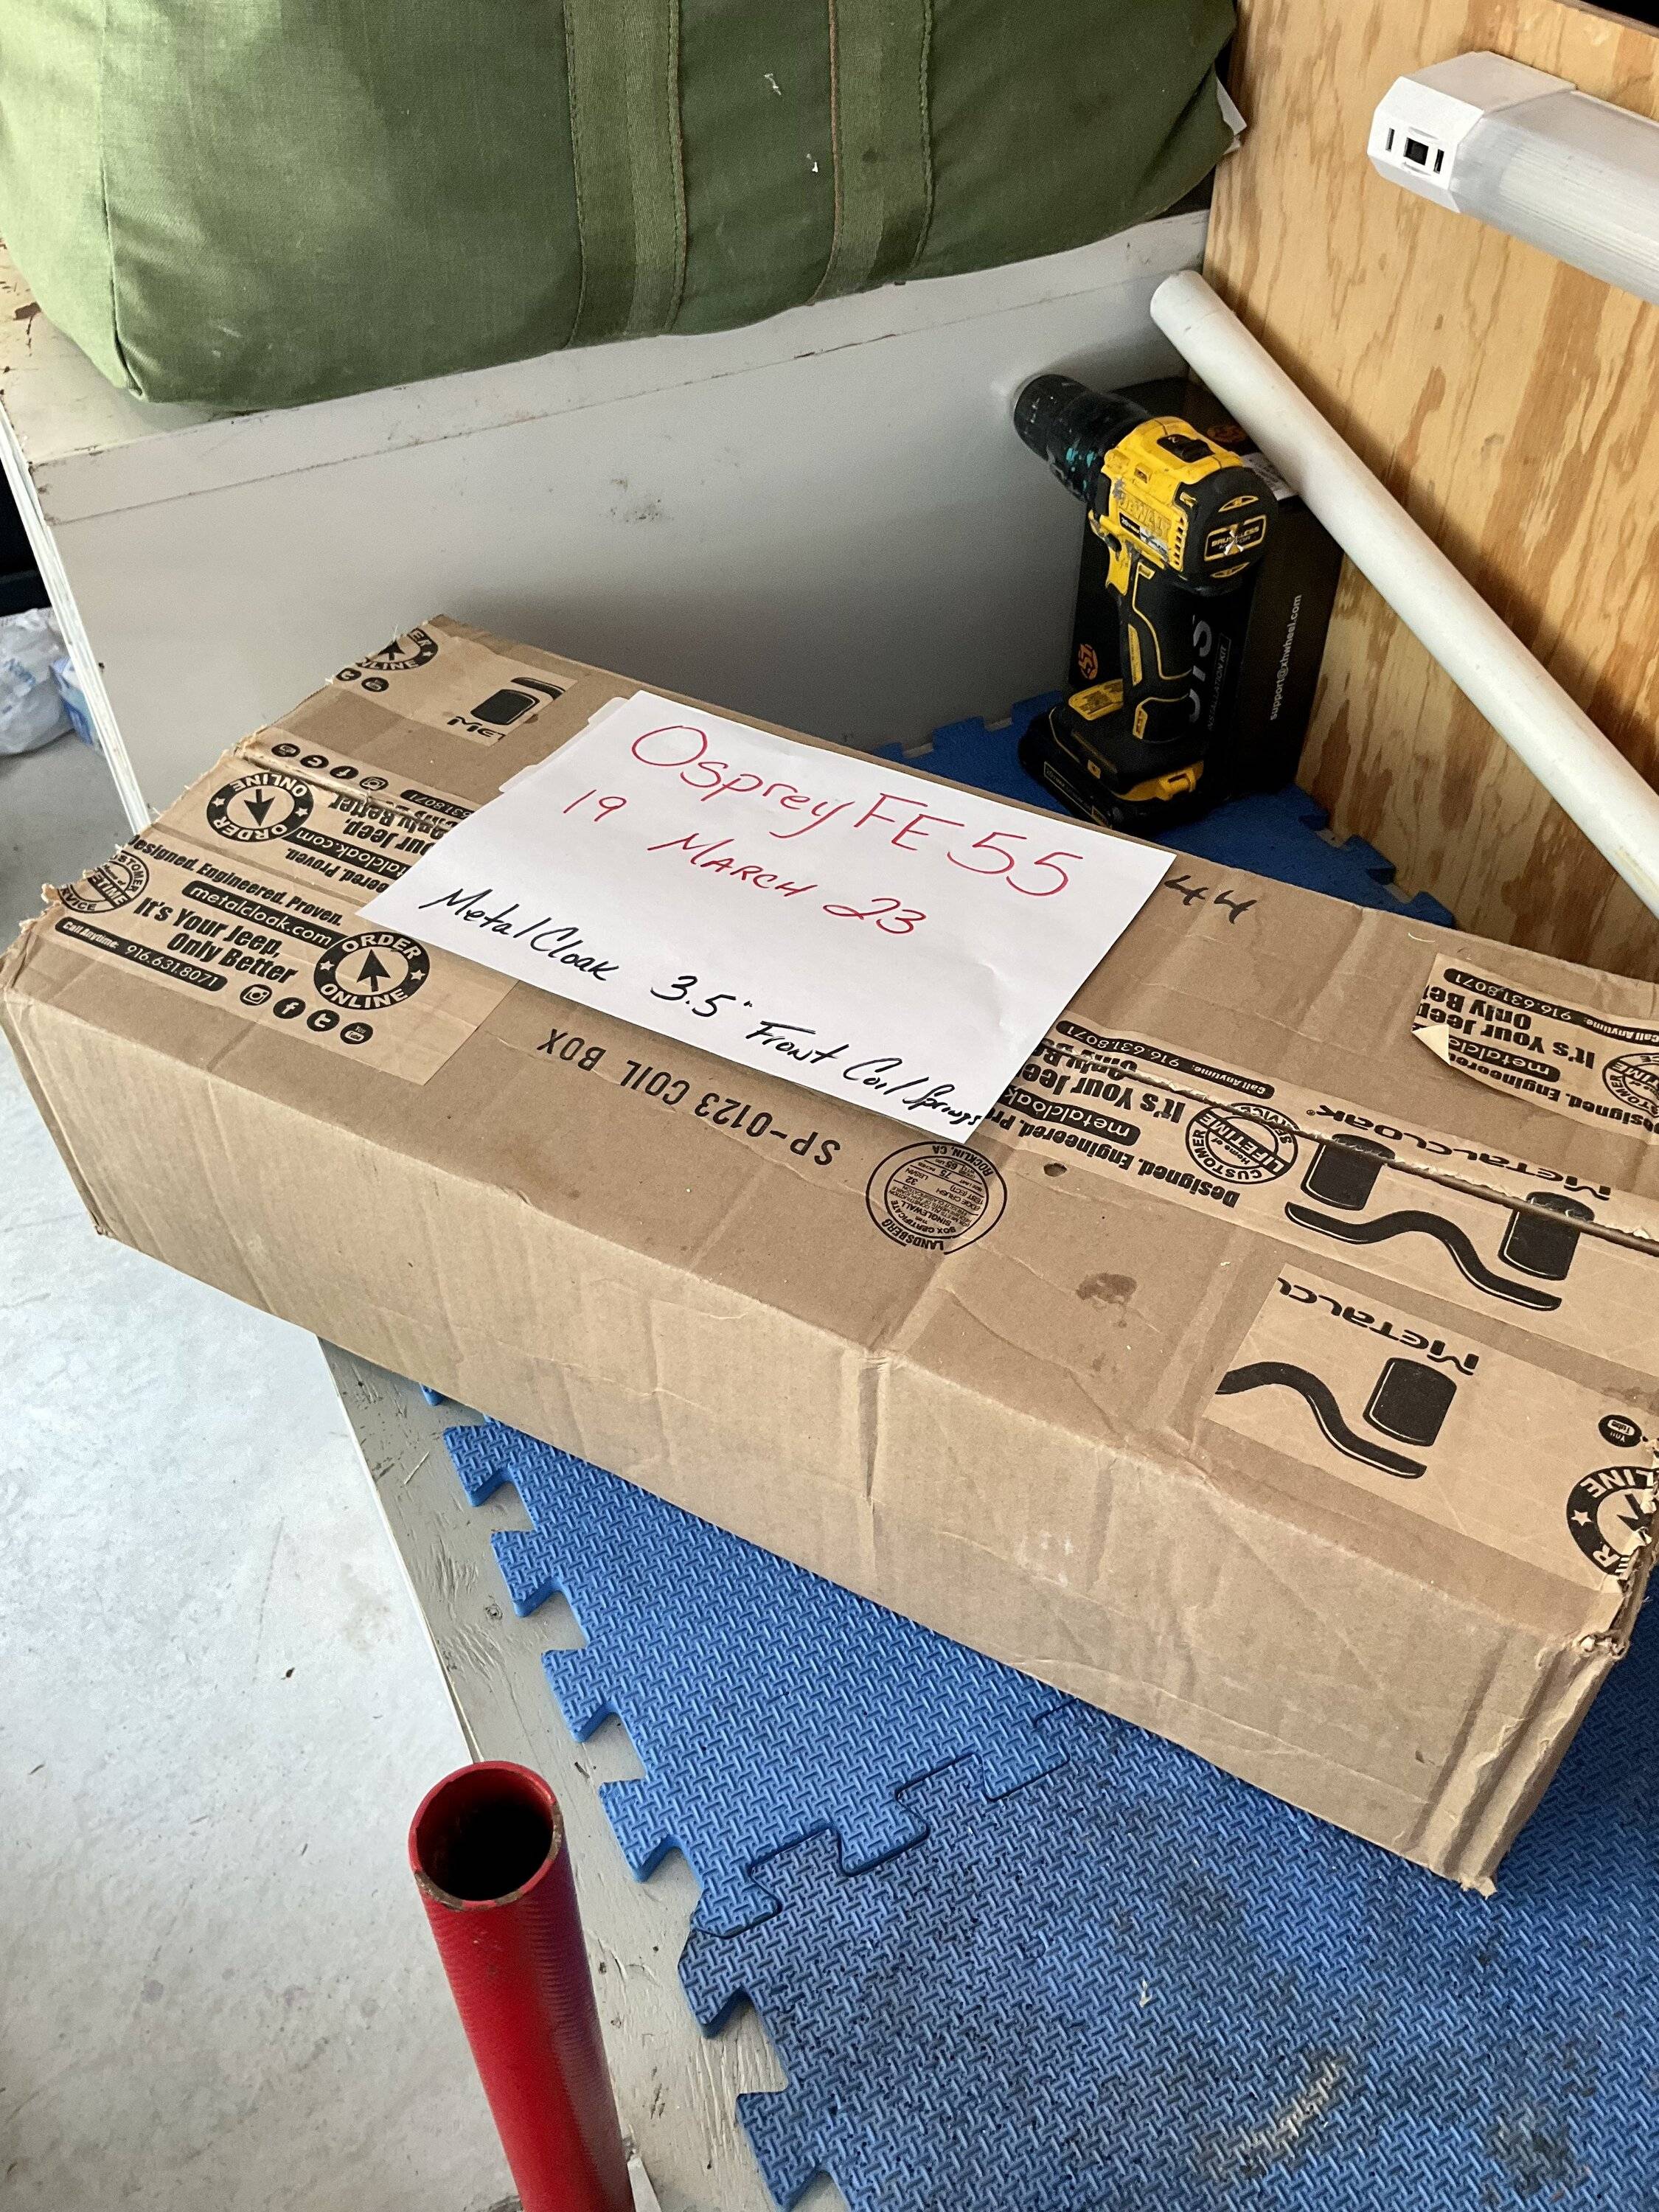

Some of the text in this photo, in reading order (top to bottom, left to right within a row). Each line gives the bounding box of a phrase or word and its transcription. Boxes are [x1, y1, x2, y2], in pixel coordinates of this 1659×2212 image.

[362, 658, 419, 670] LINE
[1270, 594, 1302, 720] support@xhwheel.com
[213, 773, 307, 841] ORDER ONLINE
[343, 818, 399, 849] Jeep,
[285, 848, 389, 893] eered. Proven.
[296, 830, 406, 877] talcloak.com
[563, 789, 627, 822] 19
[824, 897, 927, 935] 23
[90, 873, 129, 906] ETIME
[111, 854, 145, 893] STOMER
[60, 887, 97, 911] RVICE
[196, 862, 284, 905] Engineered.
[286, 895, 341, 927] Proven.
[133, 897, 283, 959] It's Your Jeep,
[189, 886, 333, 947] metalcloak.com
[62, 921, 83, 934] Call
[125, 945, 219, 988] 916.631.8071
[167, 931, 299, 984] Only Better
[341, 933, 422, 960] ORDER
[321, 982, 408, 1009] ONLINE
[1455, 973, 1571, 1020] 916.631.8071
[1469, 999, 1532, 1030] Only
[1067, 1025, 1180, 1068] 916.631.8071
[1447, 1037, 1551, 1075] metalclo
[1481, 1023, 1545, 1054] Your
[1552, 1041, 1596, 1069] It's
[1635, 1032, 1659, 1043] Call
[745, 1020, 849, 1063] Front
[843, 1057, 929, 1096] Coil
[902, 1084, 985, 1127] Springs
[1242, 1081, 1266, 1095] Call
[536, 1028, 841, 1166] SP-0123 COIL BOX
[1004, 1086, 1131, 1138] metalcloak
[1015, 1063, 1186, 1124] It's Your Jee
[1610, 1075, 1659, 1114] STOMER
[931, 1145, 995, 1178] ROCKLIN, CA
[1018, 1119, 1135, 1171] Engineered.
[1192, 1129, 1263, 1180] CUSTOMER
[1199, 1113, 1285, 1173] LIFETIME
[1211, 1137, 1251, 1165] Home of
[939, 1168, 952, 1179] 75
[945, 1160, 958, 1170] 65
[1138, 1157, 1241, 1208] Designed.
[905, 1175, 981, 1211] EDGE CRUSH 32
[949, 1184, 967, 1197] (ECT)
[967, 1193, 984, 1204] TEST
[890, 1200, 935, 1234] CERTIFICATE
[900, 1200, 953, 1226] SINGLEWALL
[881, 1218, 945, 1251] LANDSBERG
[1579, 1468, 1654, 1499] LINE
